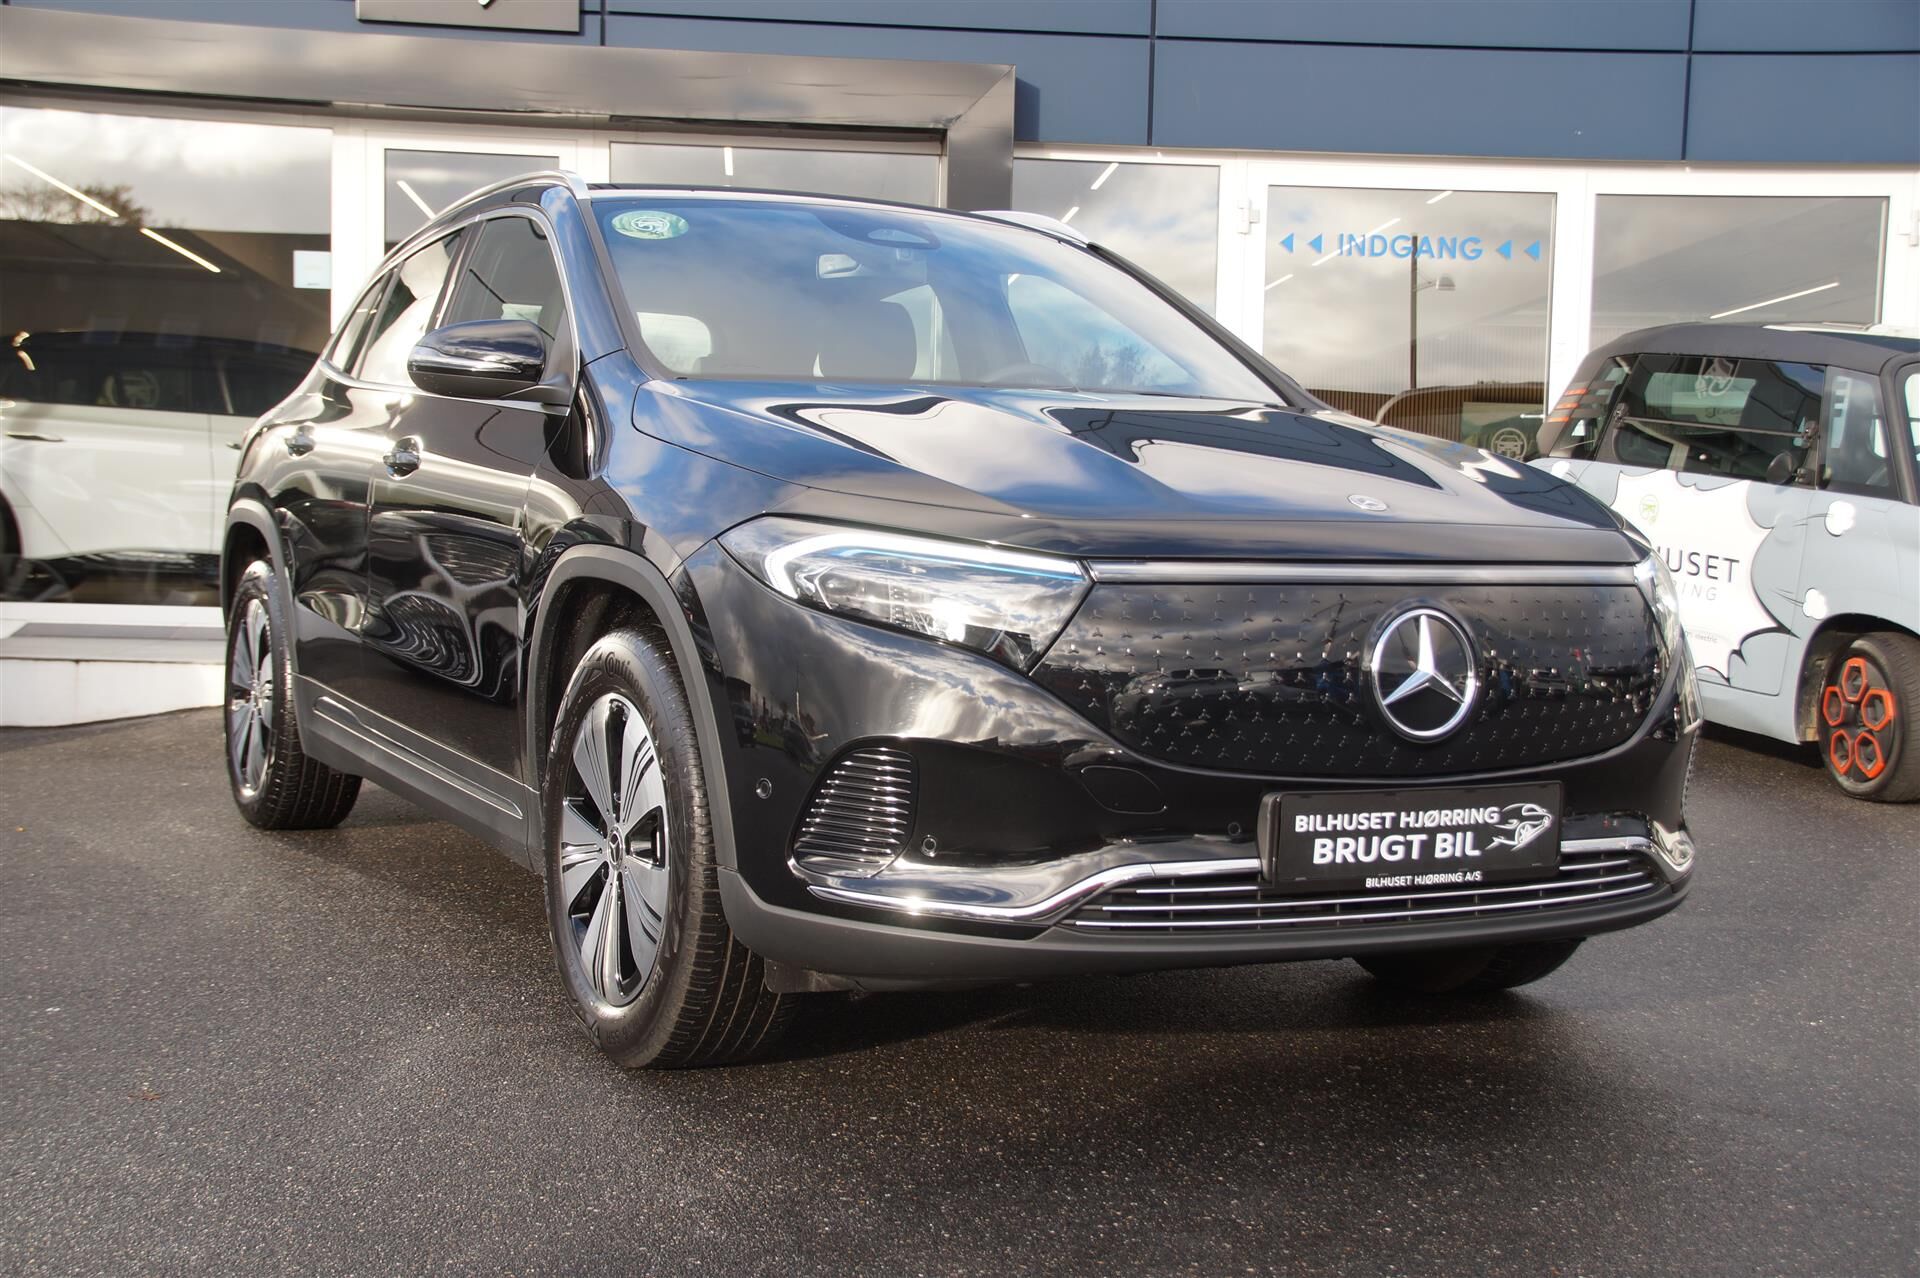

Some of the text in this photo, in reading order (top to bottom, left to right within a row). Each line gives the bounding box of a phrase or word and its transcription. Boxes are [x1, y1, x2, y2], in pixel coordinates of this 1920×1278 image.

[1336, 233, 1483, 261] INDGANG
[1673, 580, 1717, 601] ING
[1294, 806, 1500, 833] BILHUSET HJØRRING
[1312, 831, 1482, 865] BRUGT BIL
[1365, 870, 1482, 888] BILHUSET HJØRRING A/S
